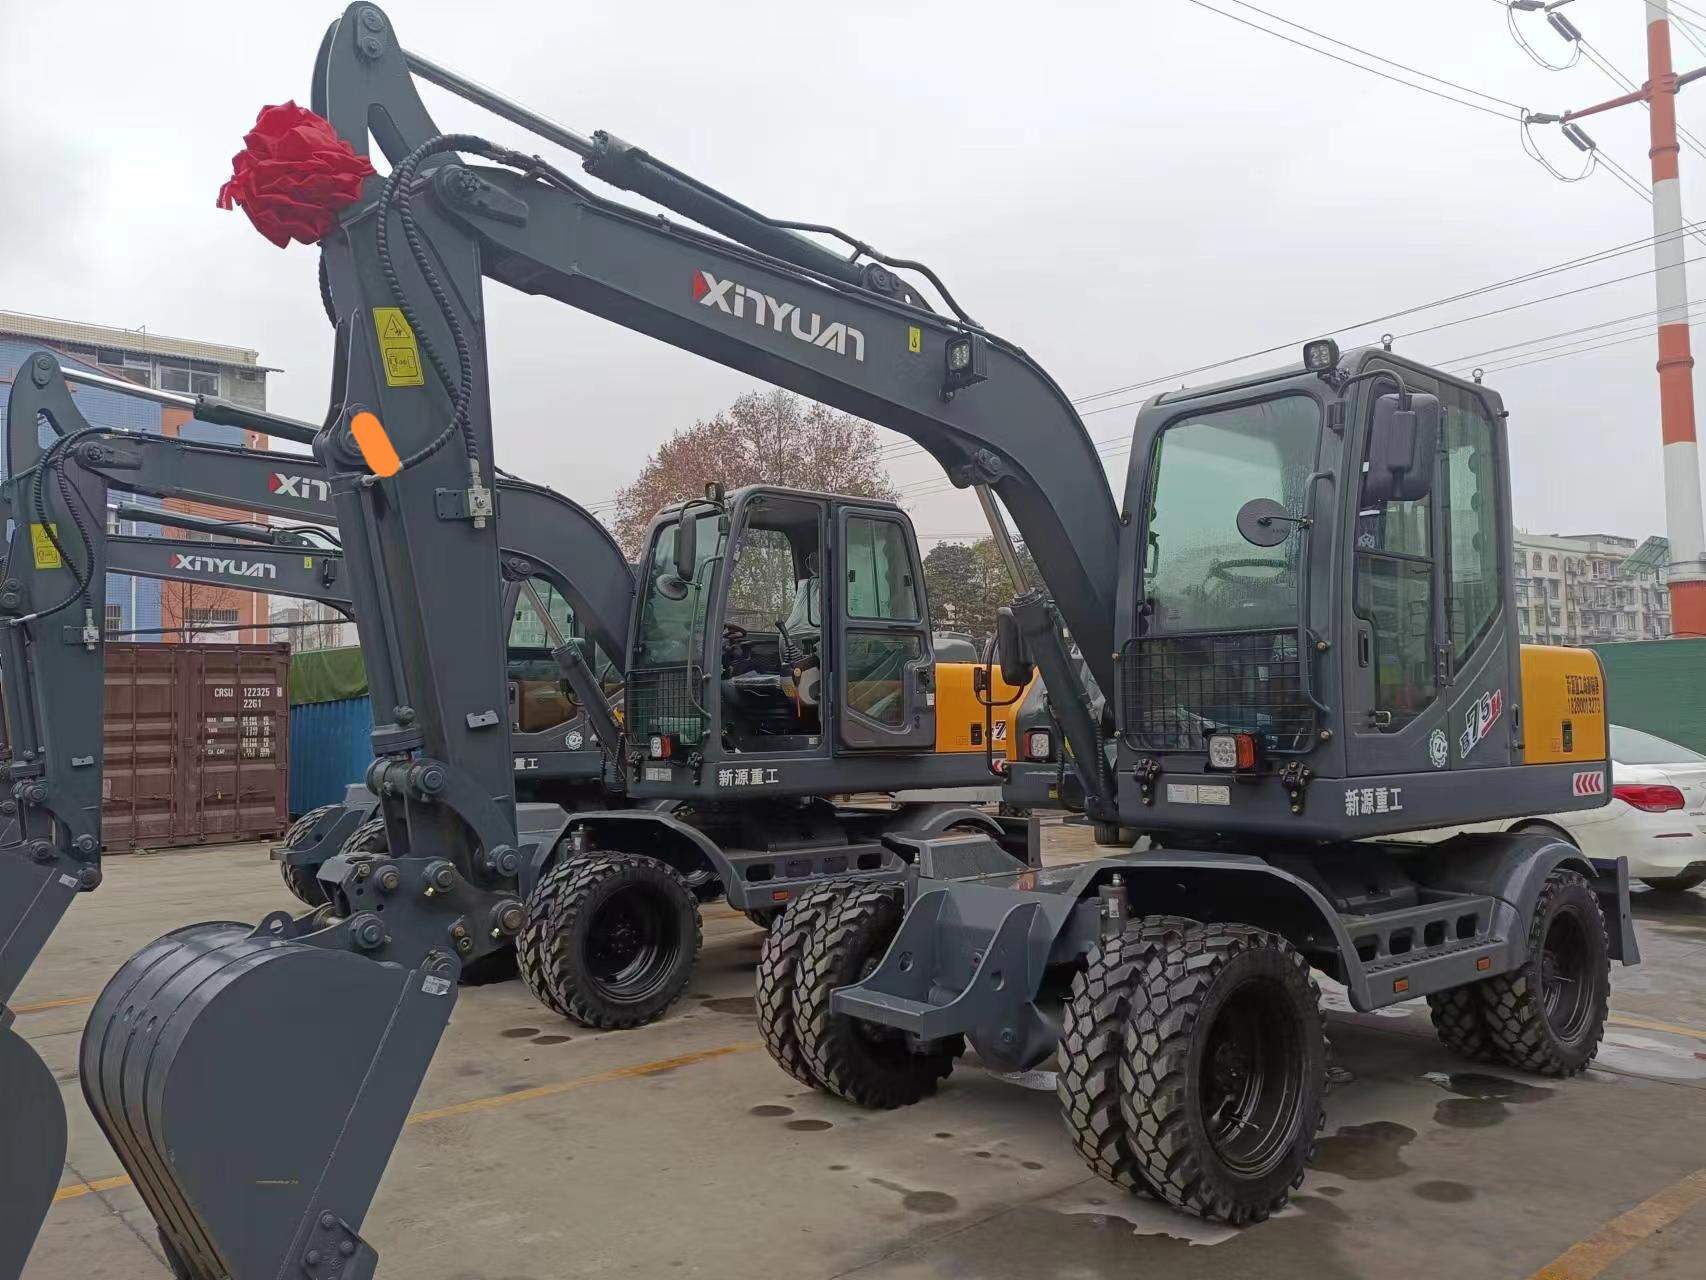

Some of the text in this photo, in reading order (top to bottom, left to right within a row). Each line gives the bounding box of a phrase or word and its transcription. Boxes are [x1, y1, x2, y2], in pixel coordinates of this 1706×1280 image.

[273, 472, 332, 502] XIN
[243, 687, 270, 697] 122325
[718, 768, 780, 787] 新源重工
[1345, 787, 1403, 816] 新源重工
